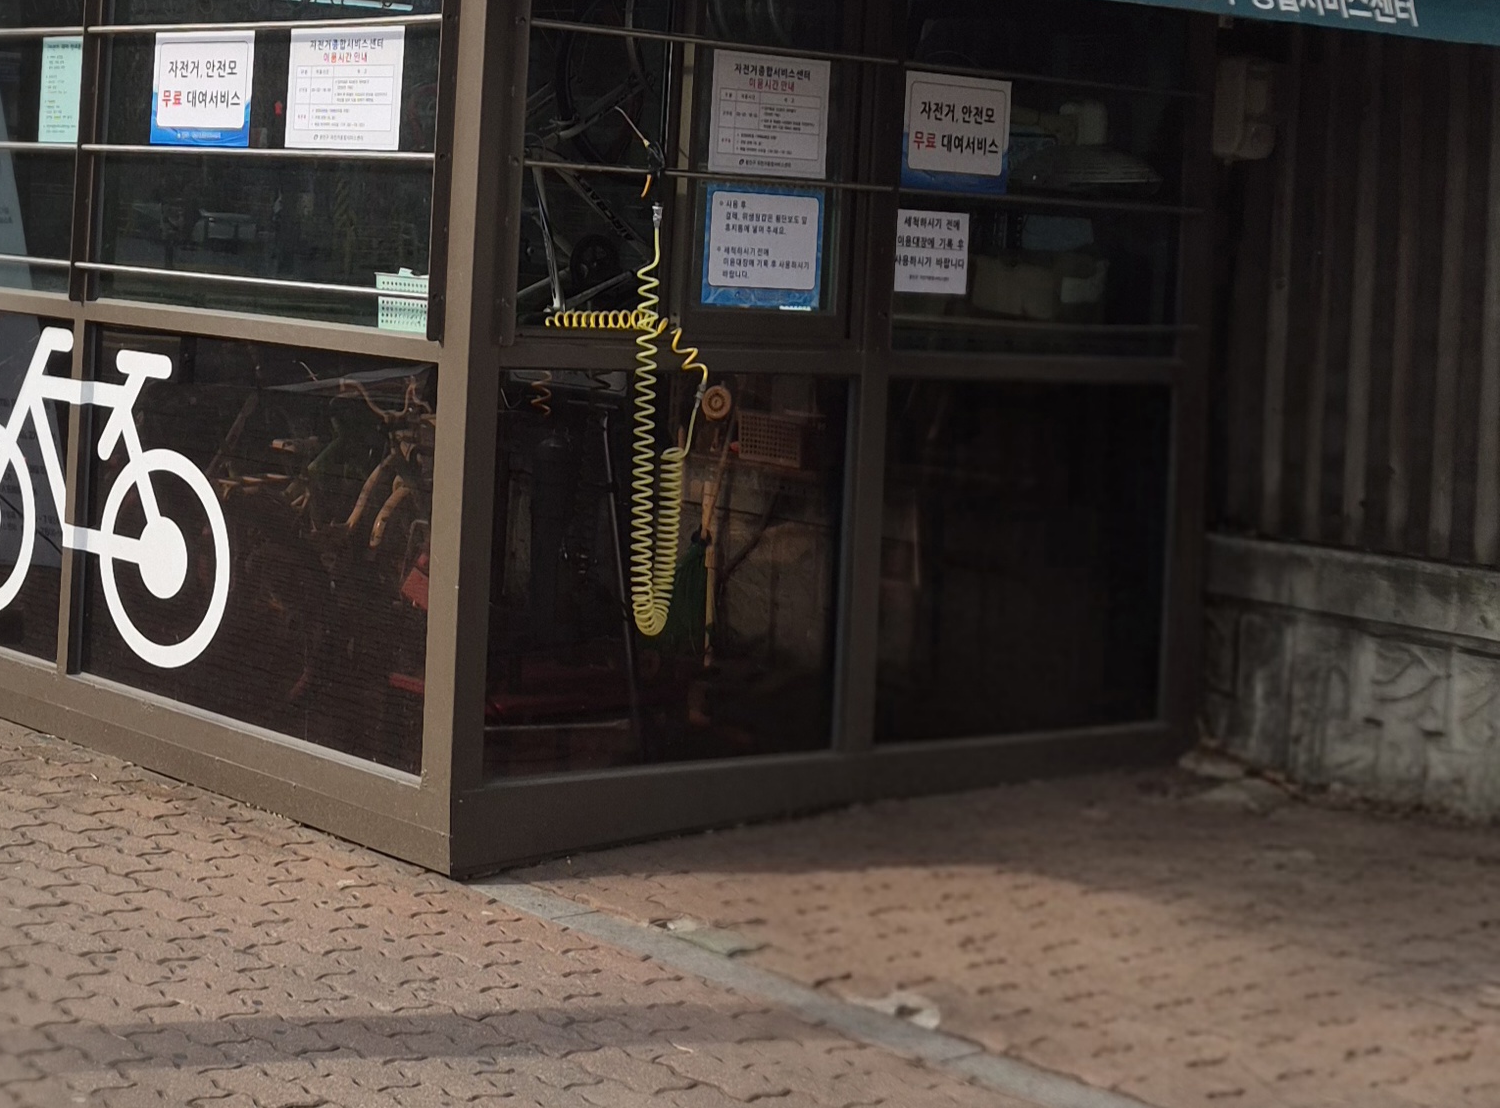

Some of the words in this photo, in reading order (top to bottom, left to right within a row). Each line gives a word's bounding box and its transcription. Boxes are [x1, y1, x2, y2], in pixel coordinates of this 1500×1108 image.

[205, 58, 238, 78] 안전모
[162, 91, 183, 107] 무료
[186, 89, 241, 108] 대여서비스
[961, 106, 995, 125] 안전모
[913, 131, 936, 150] 무료
[941, 134, 999, 156] 대여서비스
[904, 216, 942, 230] 세척하시기
[946, 219, 960, 231] 전에
[897, 235, 935, 248] 이용대장에
[957, 239, 964, 250] 후
[936, 257, 964, 269] 바랍니다
